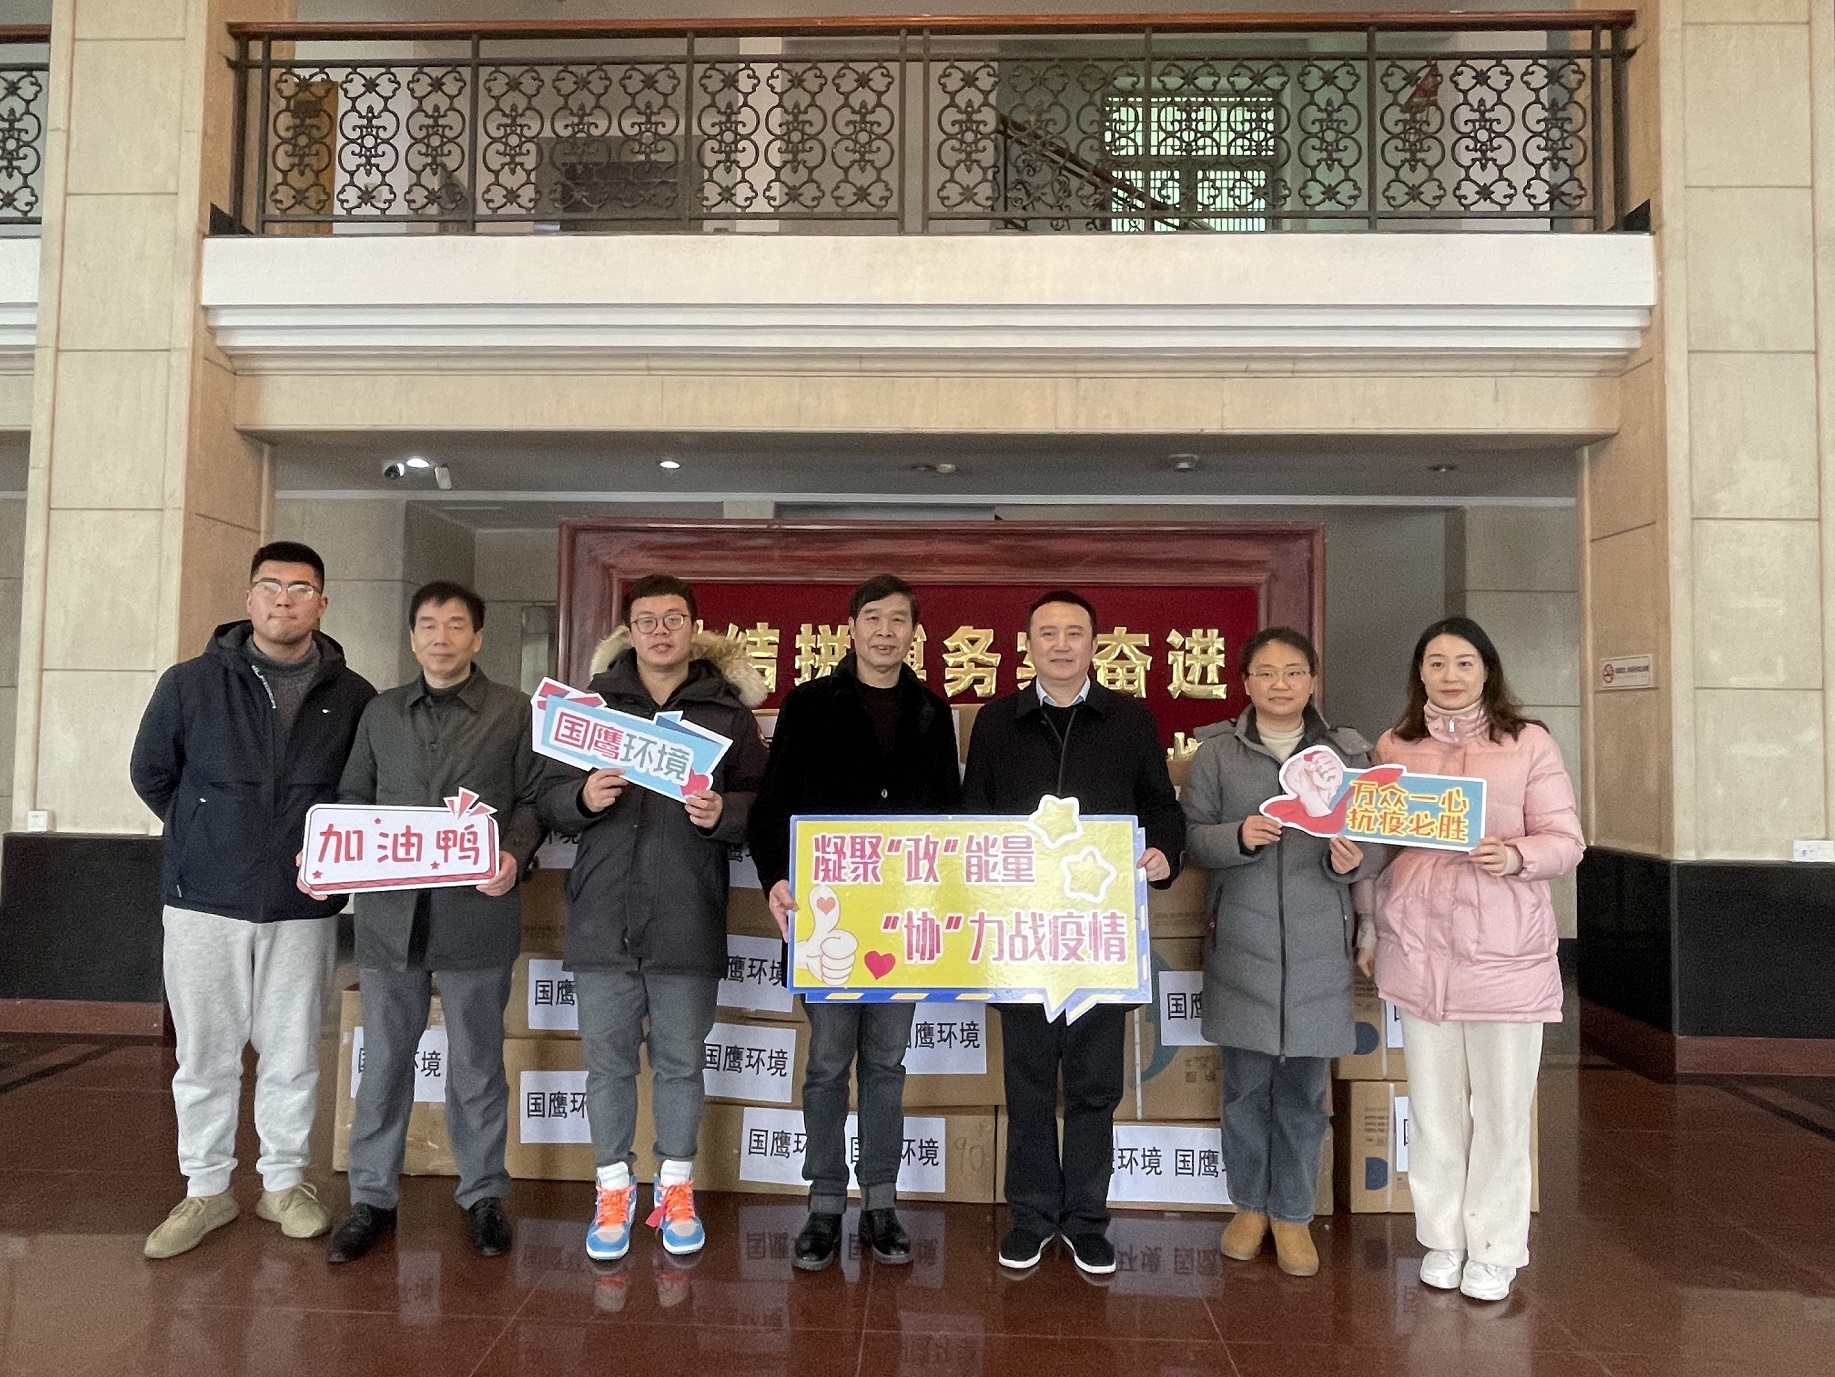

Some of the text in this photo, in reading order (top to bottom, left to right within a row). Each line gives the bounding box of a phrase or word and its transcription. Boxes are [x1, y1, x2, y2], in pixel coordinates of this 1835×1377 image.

[554, 711, 690, 781] 国鹰环境
[1350, 780, 1468, 813] 万众一心
[317, 823, 480, 866] 加油鸭
[1348, 807, 1468, 842] 抗疫必胜
[813, 834, 1035, 883] 凝聚"政"能量
[882, 911, 1126, 962] "协"力战疫情
[705, 1043, 789, 1078] 国鹰环境
